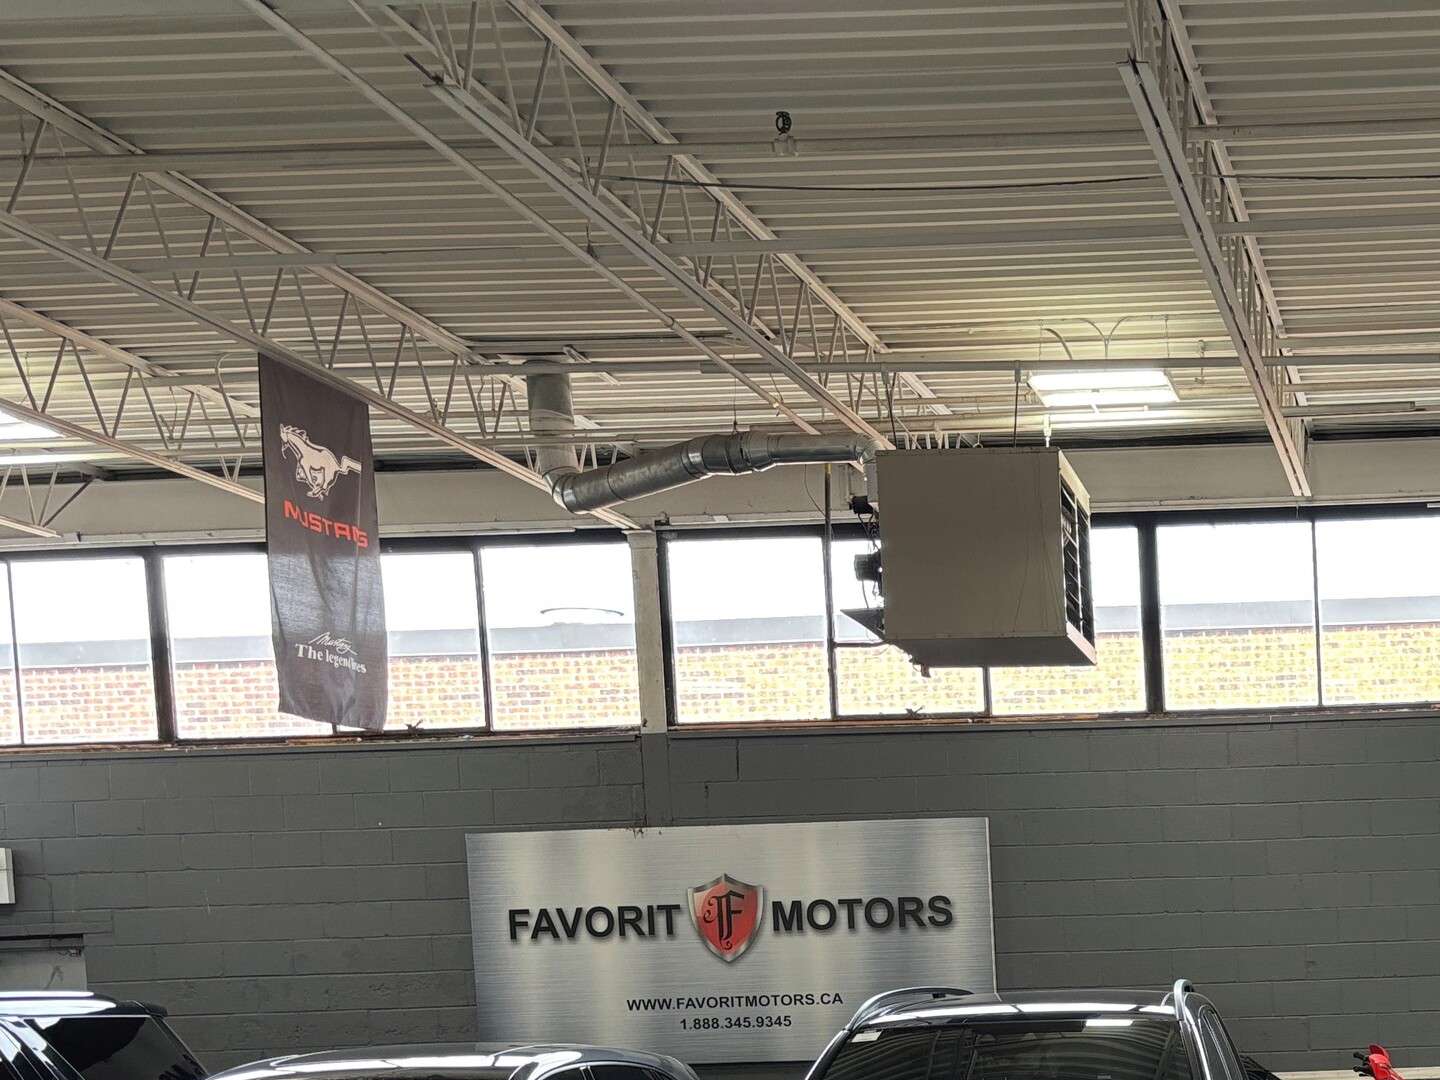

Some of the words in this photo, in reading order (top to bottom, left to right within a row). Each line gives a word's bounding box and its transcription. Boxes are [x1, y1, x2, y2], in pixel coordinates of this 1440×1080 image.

[295, 643, 324, 661] The
[507, 903, 681, 941] FAVORIT
[771, 894, 953, 933] MOTORS
[626, 991, 844, 1013] WWW.FAVORITMOTORS.CA
[679, 1015, 792, 1031] 1.888.345.9345
